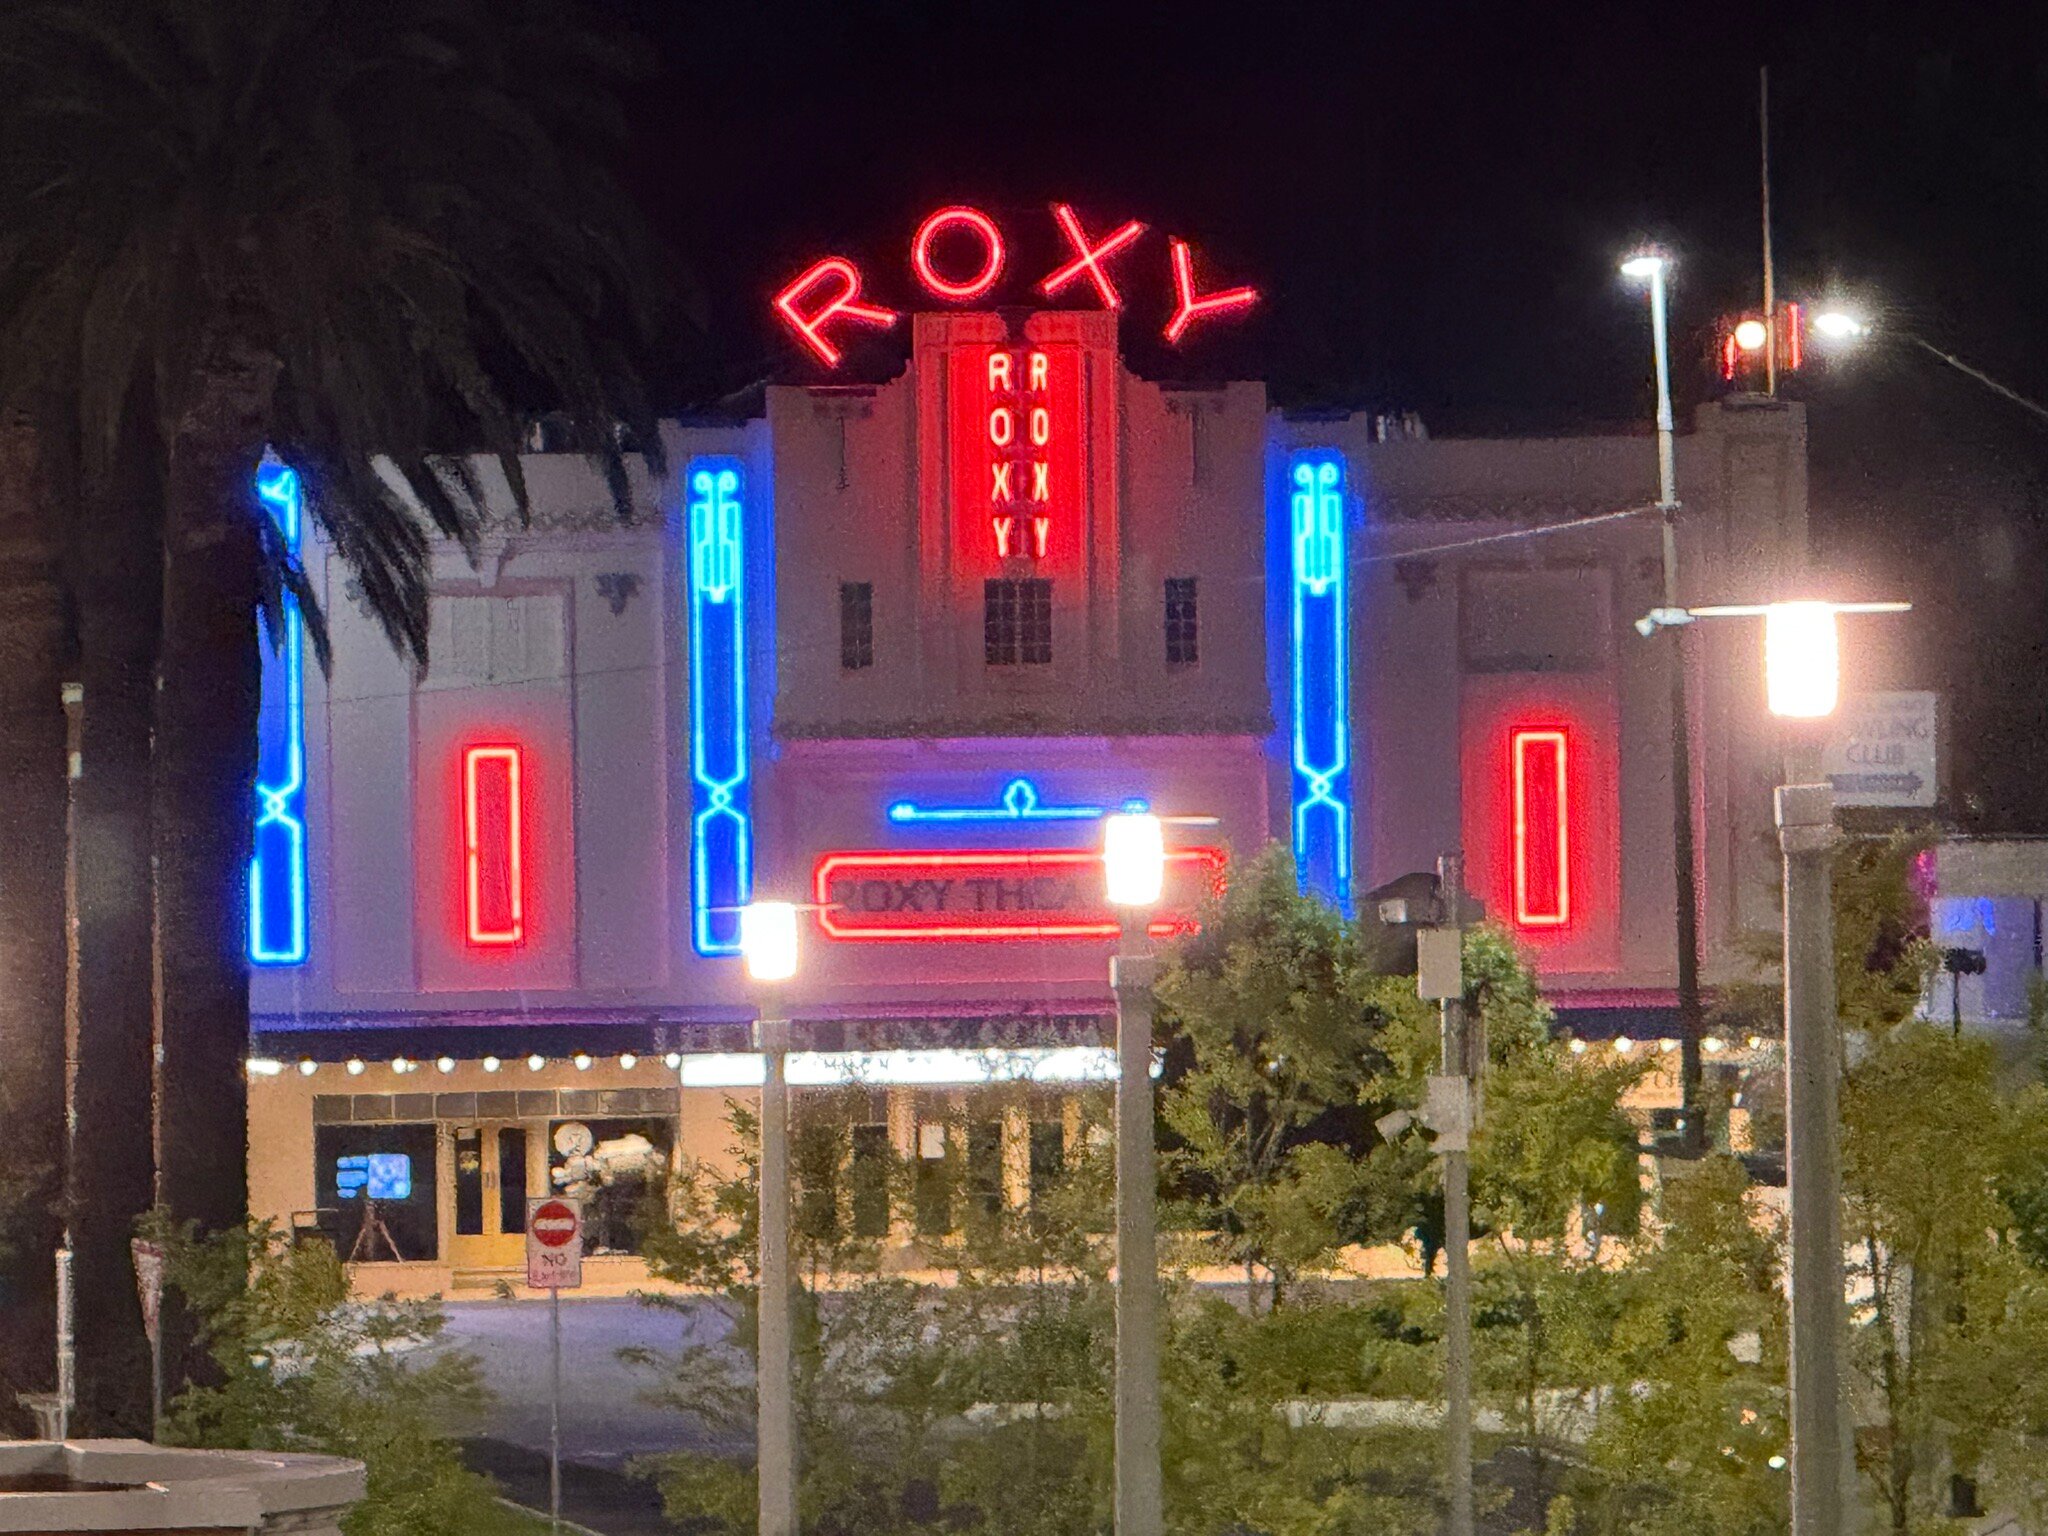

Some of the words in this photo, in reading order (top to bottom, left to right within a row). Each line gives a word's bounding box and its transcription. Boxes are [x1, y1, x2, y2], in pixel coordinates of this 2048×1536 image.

[774, 203, 1257, 366] ROXY
[989, 353, 1011, 557] ROXY
[1031, 353, 1049, 557] ROXY
[540, 1253, 568, 1267] NO
